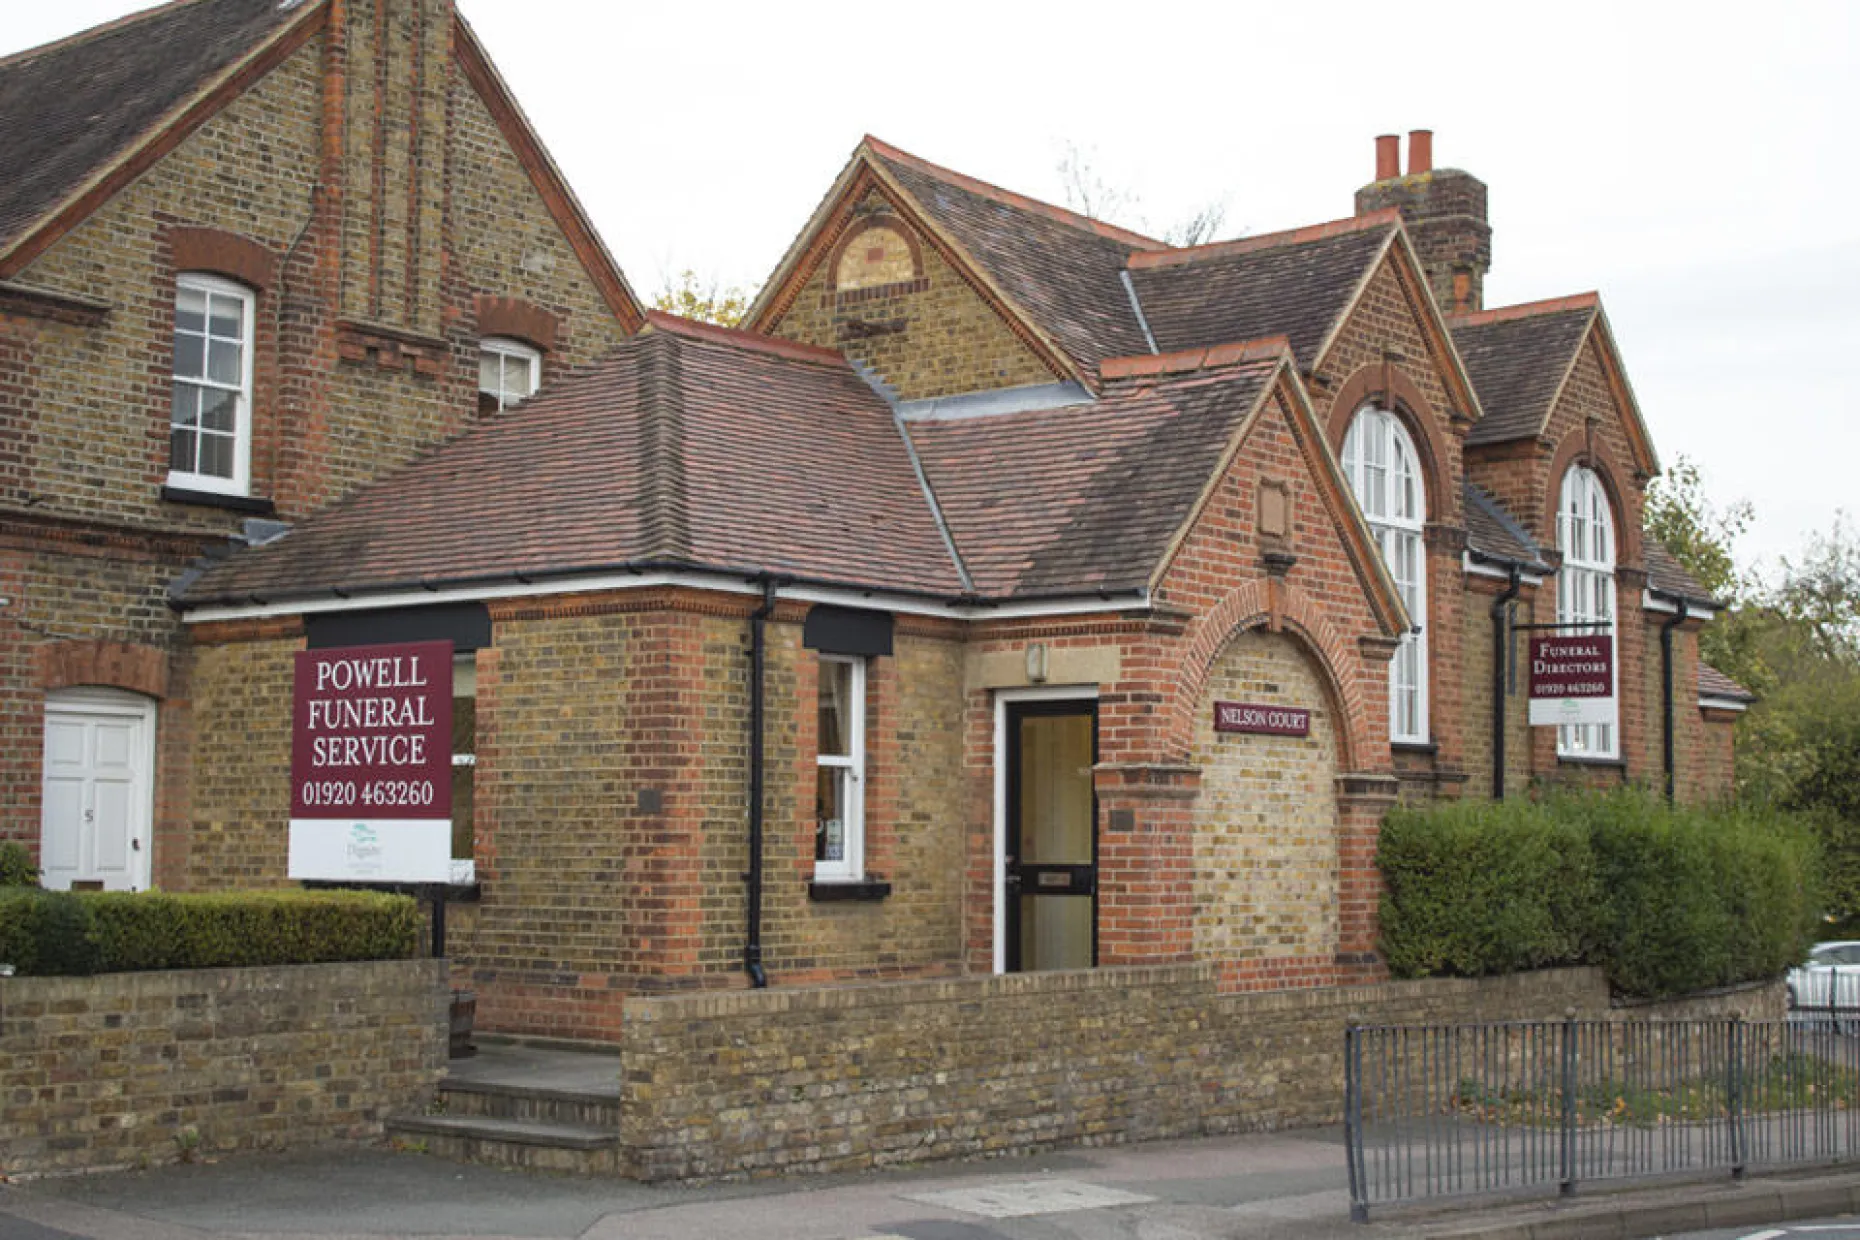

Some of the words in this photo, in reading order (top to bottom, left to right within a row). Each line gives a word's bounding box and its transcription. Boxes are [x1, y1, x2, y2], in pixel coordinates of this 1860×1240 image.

[1540, 643, 1602, 658] FUNERAL
[316, 656, 427, 690] POWELL
[307, 696, 435, 729] FUNERAL
[1222, 707, 1266, 726] NELSON
[1268, 711, 1307, 729] COURT
[312, 734, 427, 766] SERVICE
[303, 781, 356, 806] 01920
[360, 780, 434, 806] 463260
